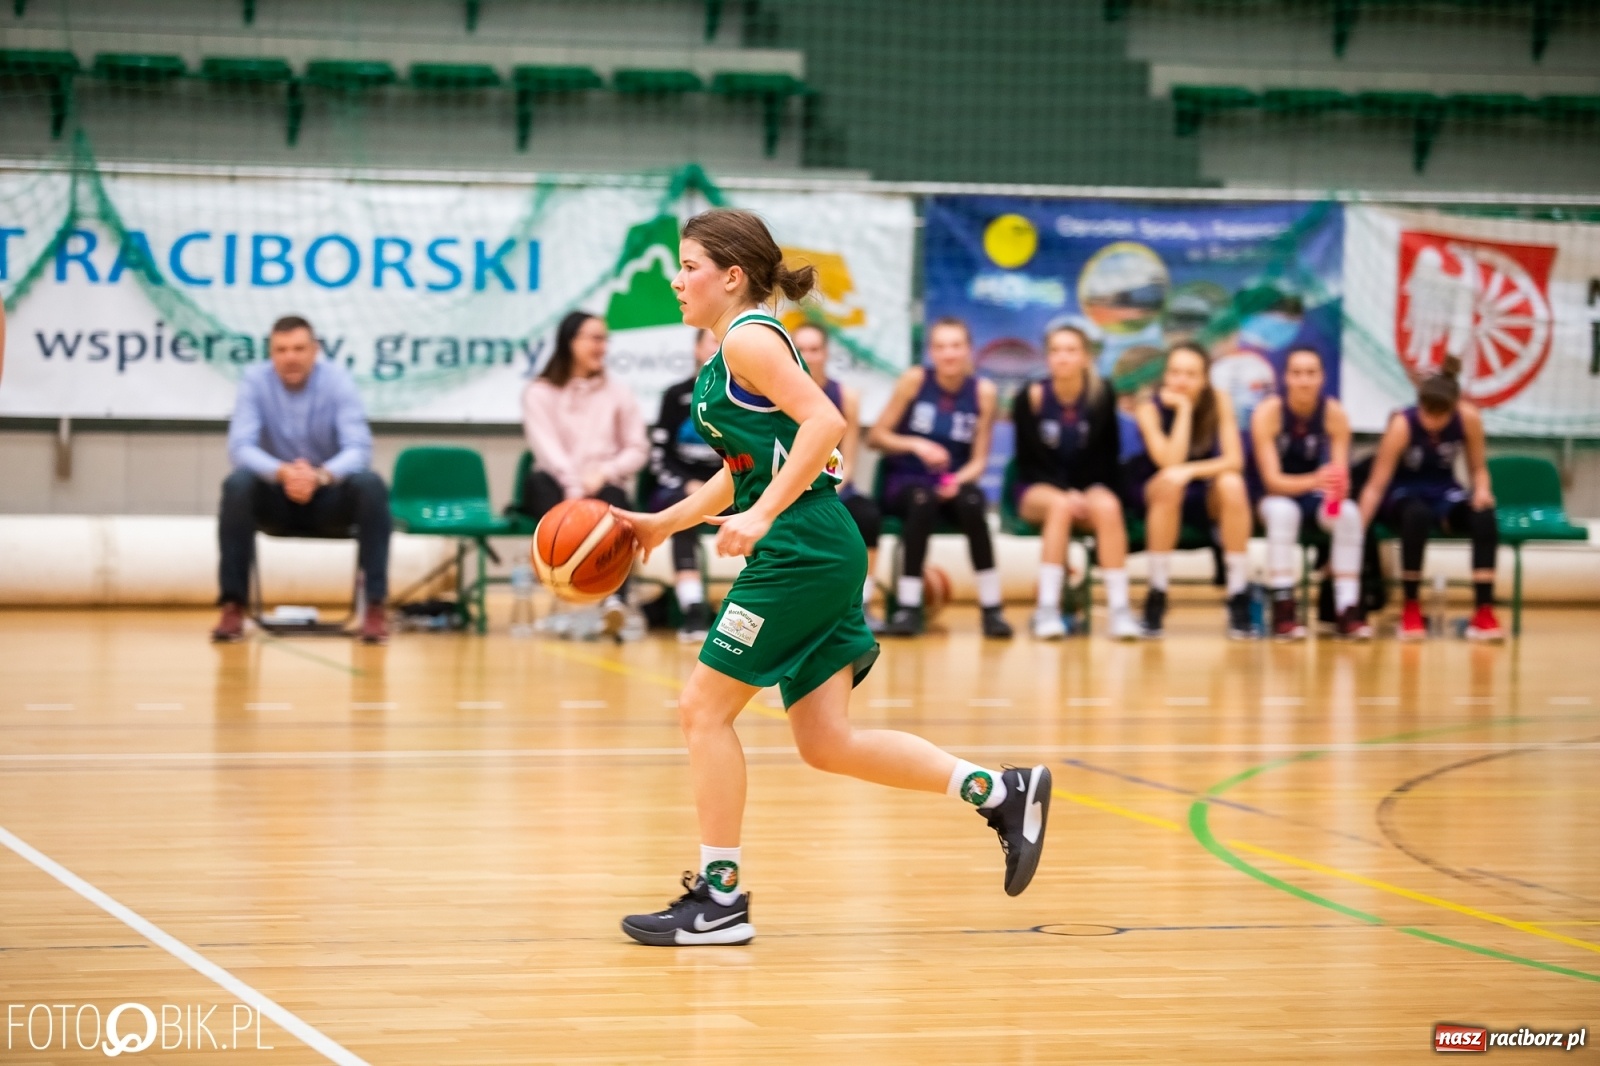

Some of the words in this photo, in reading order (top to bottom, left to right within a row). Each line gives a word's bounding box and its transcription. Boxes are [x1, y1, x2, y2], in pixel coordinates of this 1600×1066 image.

[55, 229, 542, 292] RACIBORSKI
[36, 321, 354, 371] wspieray,
[712, 637, 744, 656] COLO
